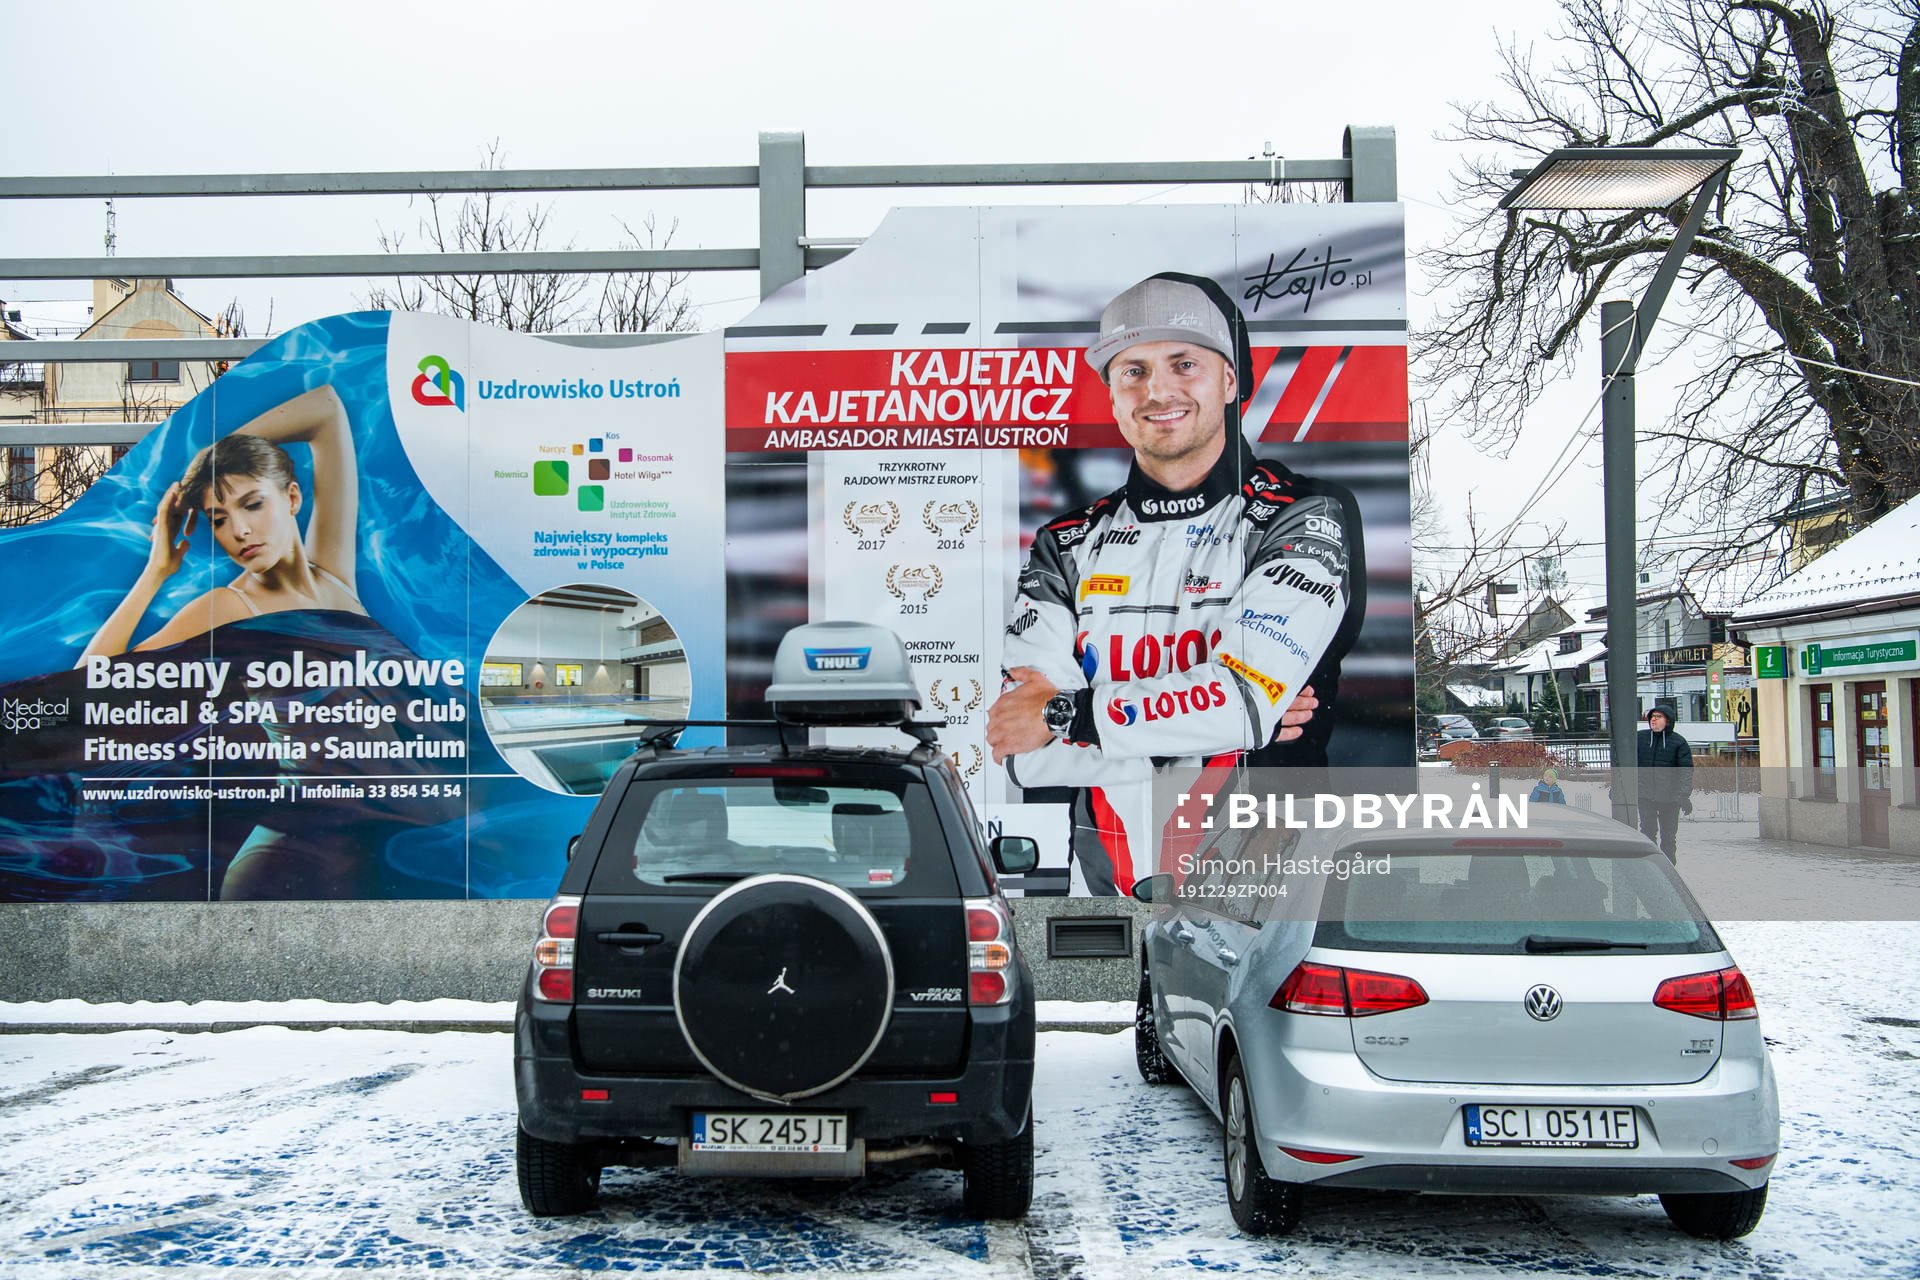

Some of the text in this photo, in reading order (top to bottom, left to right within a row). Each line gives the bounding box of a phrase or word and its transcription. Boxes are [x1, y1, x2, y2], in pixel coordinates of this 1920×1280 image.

[890, 349, 1076, 386] KAJETAN
[478, 377, 681, 400] Uzdrowisko Ustroń
[764, 388, 1072, 424] KAJETANOWICZ
[605, 432, 620, 440] Kos
[764, 423, 1069, 449] AMBASADOR MIASTA USTROŃ
[538, 445, 567, 454] Narcyz
[636, 453, 674, 462] Rosomak
[878, 462, 946, 472] TRZYKROTNY
[494, 470, 529, 479] Równica
[614, 471, 636, 480] Hotel
[843, 475, 979, 486] RAJDOWY MISTRZ EUROPY
[610, 500, 669, 510] Uzdrowiskowy
[1159, 494, 1206, 514] LOTOS
[610, 510, 677, 520] Instytut Zdrowia
[1305, 517, 1343, 541] OMP
[533, 530, 668, 546] Największy kompleks
[857, 540, 886, 550] 2017
[936, 539, 965, 550] 2016
[533, 545, 668, 559] zdrowia i wypoczynku
[577, 559, 625, 570] w Polsce
[900, 604, 928, 614] 2015
[904, 641, 956, 651] OKROTNY
[943, 654, 980, 664] POLSKI
[1832, 646, 1904, 663] Informacja Turystyczna
[815, 656, 861, 669] THULE
[87, 650, 466, 698] Baseny solankowe
[951, 687, 960, 702] 1
[3, 697, 69, 716] Medical
[1143, 681, 1227, 722] LOTOS
[84, 697, 466, 729] Medical & SPA Prestige Club
[5, 711, 41, 735] Spa
[944, 715, 969, 726] 2012
[84, 734, 466, 762] Fitness Siłownia Saunarium
[83, 784, 462, 802] www.uzdrowisko-ustron.pl Infolinia 33 854 54 54
[587, 988, 642, 998] SUZUKI
[910, 992, 962, 1001] VITARA
[1363, 1035, 1410, 1047] GOLF
[1483, 1109, 1630, 1139] SCI 0511F
[711, 1118, 844, 1145] SK 245JT
[1469, 1126, 1480, 1135] PL
[694, 1133, 705, 1142] PL
